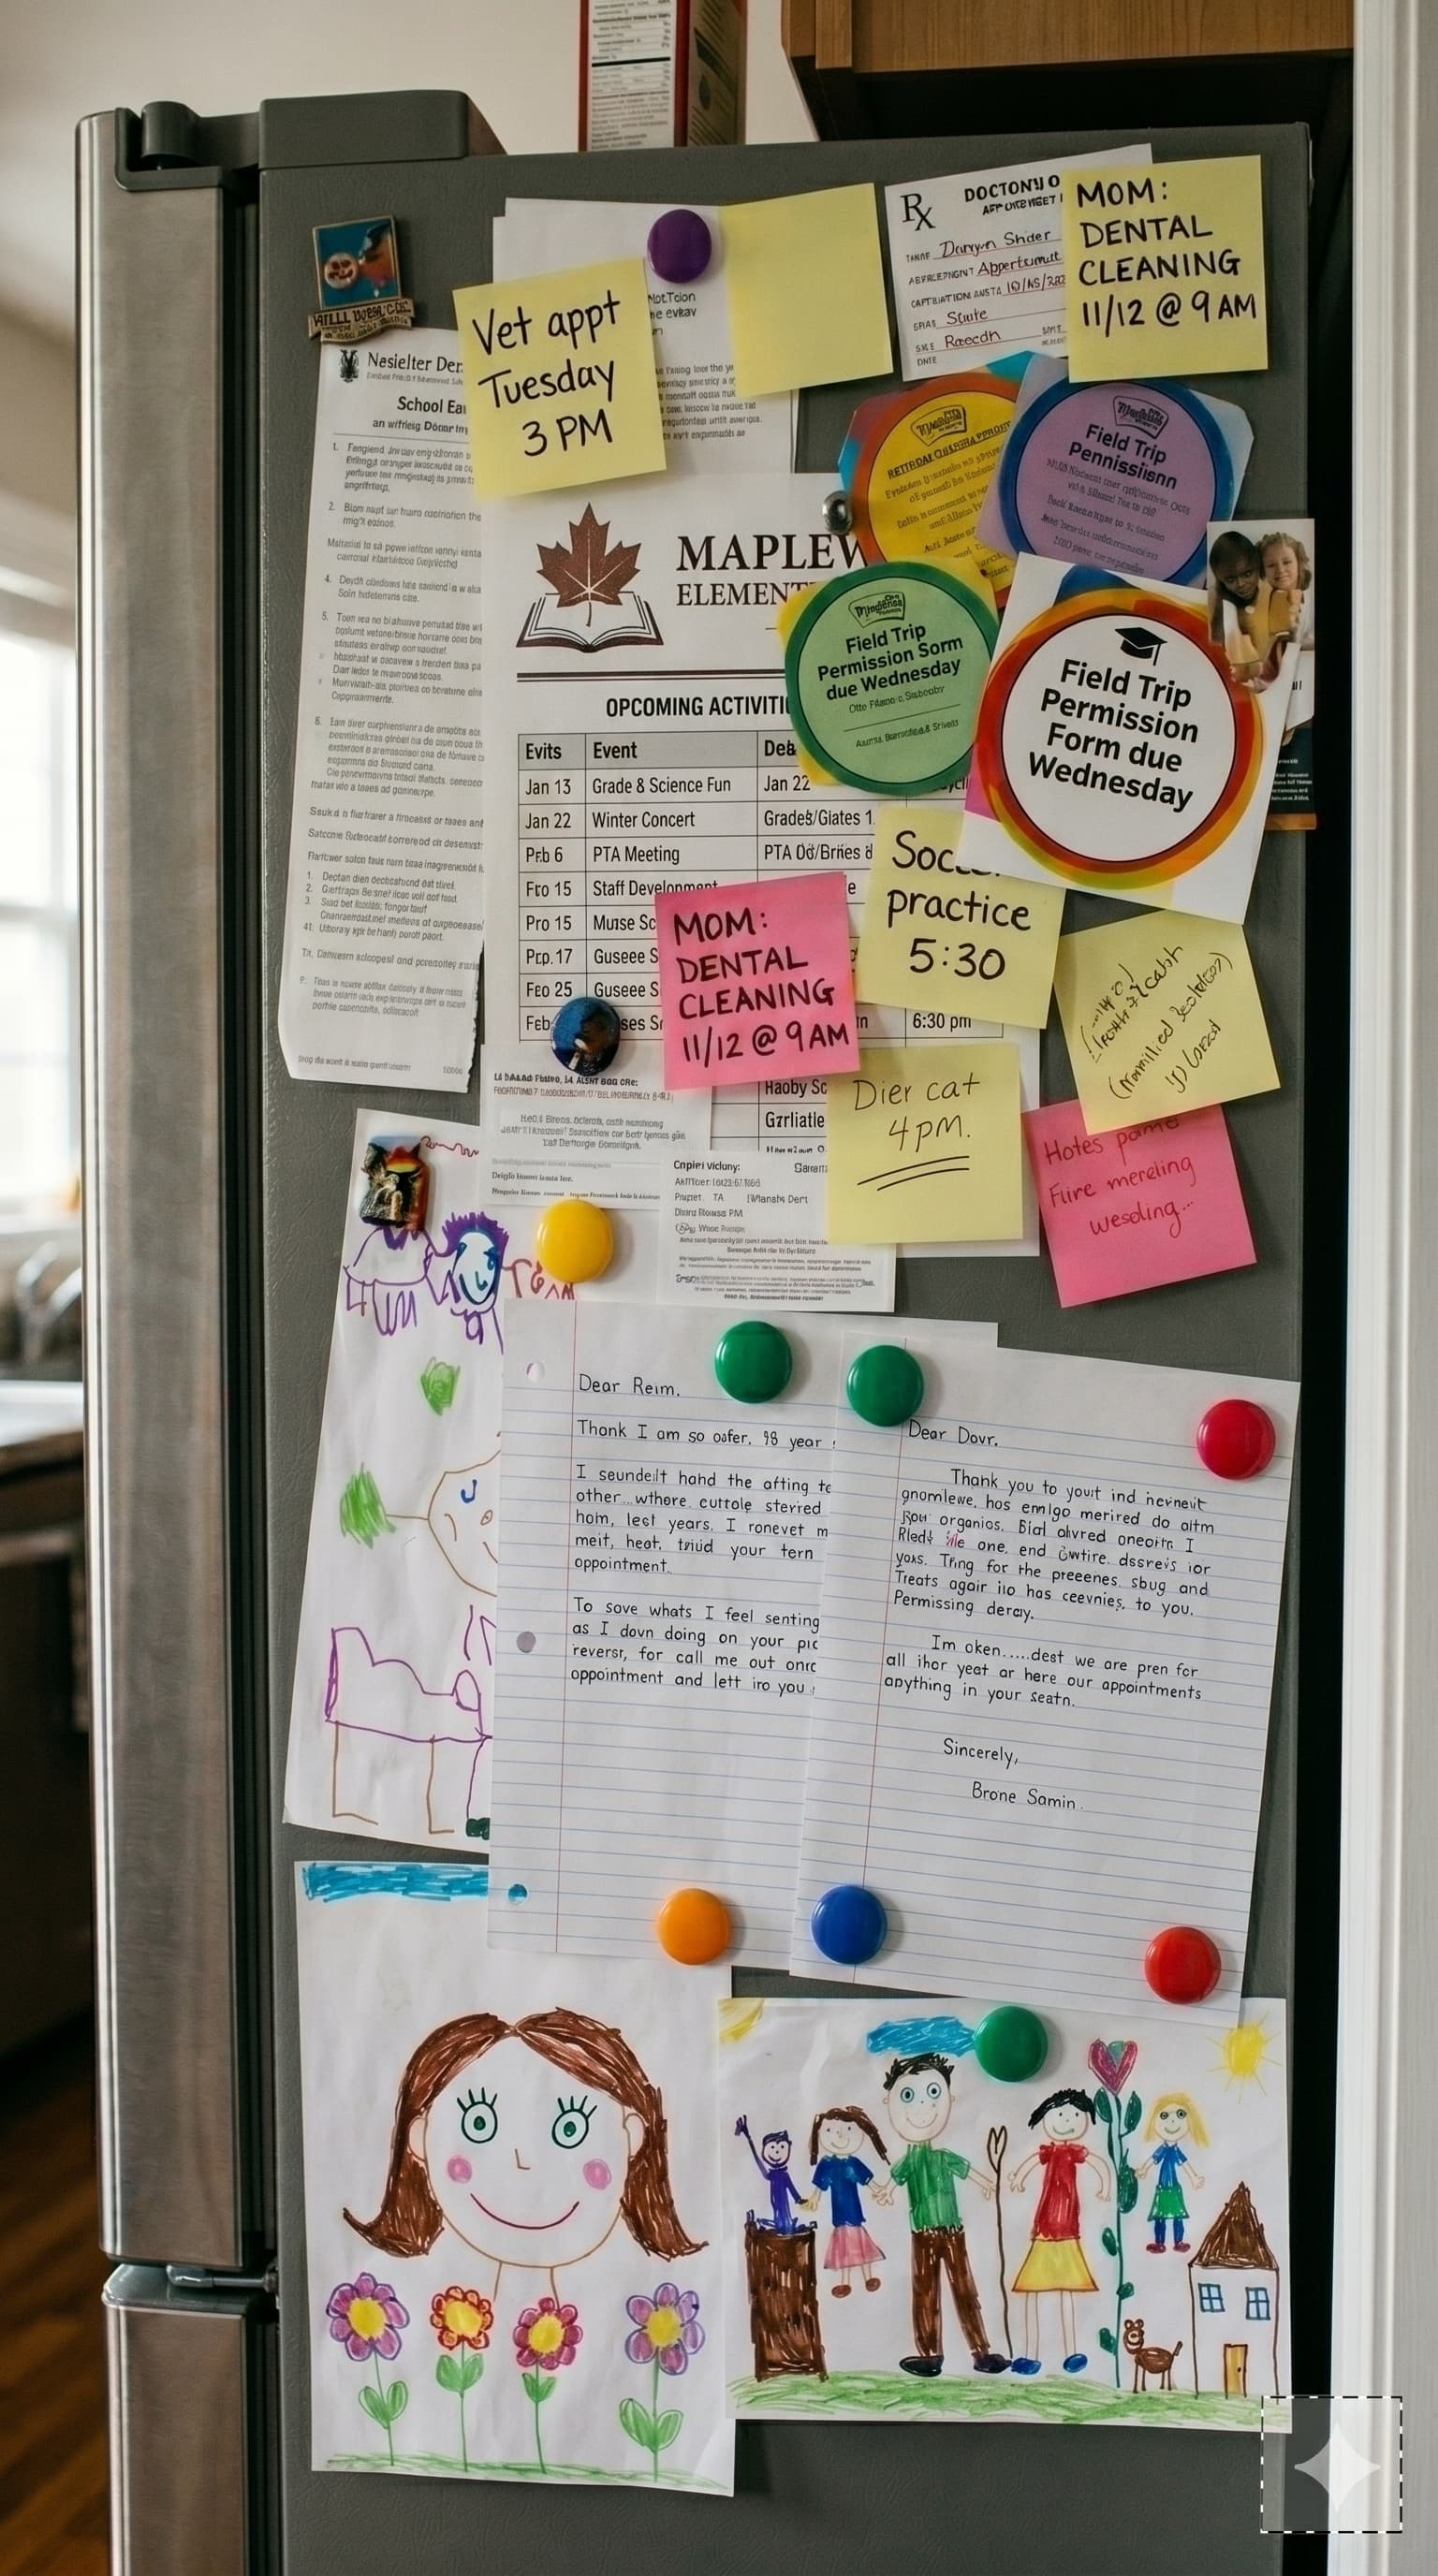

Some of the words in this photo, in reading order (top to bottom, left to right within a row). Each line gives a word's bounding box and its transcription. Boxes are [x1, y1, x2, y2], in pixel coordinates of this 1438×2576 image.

[1077, 177, 1167, 208] MOM:
[1080, 215, 1212, 248] DENTAL
[1078, 249, 1241, 286] CLEANING
[473, 306, 532, 356] Vet
[548, 289, 620, 350] appt
[1082, 294, 1146, 337] 11/12
[1156, 293, 1182, 327] @
[477, 359, 614, 408] Tuesday
[397, 396, 443, 413] School
[522, 420, 548, 457] 3
[557, 409, 612, 450] PM
[1086, 423, 1130, 452] Field
[1135, 439, 1167, 465] Trip
[846, 630, 888, 654] Field
[891, 623, 926, 643] Trip
[817, 648, 914, 681] Permission
[827, 684, 858, 700] due
[860, 659, 961, 692] Wednesday
[1061, 658, 1131, 696] Field
[1138, 673, 1192, 713] Trip
[607, 697, 703, 717] OPCOMING
[1040, 687, 1199, 744] Permission
[525, 742, 562, 760] Evits
[593, 741, 638, 759] Event
[1047, 723, 1121, 761] Form
[1129, 734, 1182, 773] due
[525, 779, 550, 795] Jan
[554, 779, 571, 795] 13
[593, 778, 633, 795] Grade
[650, 777, 703, 793] Science
[707, 776, 731, 793] Fun
[764, 775, 788, 792] Jan
[793, 775, 811, 791] 22
[1029, 751, 1194, 814] Wednesday
[525, 813, 550, 829] Jan
[553, 812, 571, 828] 22
[592, 812, 638, 828] Winter
[641, 811, 696, 827] Concert
[594, 846, 621, 862] PTA
[625, 845, 680, 865] Meeting
[764, 844, 792, 860] PTA
[554, 881, 572, 897] 15
[594, 880, 625, 897] Staff
[554, 915, 572, 930] 15
[888, 889, 1032, 931] practice
[674, 907, 768, 945] MOM:
[556, 948, 573, 964] 17
[677, 945, 809, 984] DENTAL
[909, 938, 1005, 980] 5:30
[554, 981, 572, 997] 25
[679, 978, 835, 1019] CLEANING
[913, 1013, 946, 1029] 6:30
[950, 1017, 972, 1032] pm
[682, 1027, 744, 1068] 11/12
[752, 1024, 777, 1056] @
[926, 1072, 980, 1101] cat
[580, 1373, 621, 1393] Dear
[638, 1424, 648, 1439] I
[688, 1430, 705, 1443] so
[789, 1438, 823, 1453] year
[909, 1418, 947, 1441] Dear
[577, 1464, 587, 1479] I
[727, 1472, 753, 1489] the
[950, 1469, 998, 1488] Thank
[1008, 1479, 1034, 1497] you
[1042, 1479, 1057, 1495] to
[726, 1517, 736, 1532] I
[1152, 1515, 1170, 1529] do
[730, 1544, 766, 1561] your
[1020, 1543, 1046, 1558] end
[1185, 1538, 1195, 1553] I
[894, 1589, 974, 1617] Permissing
[895, 1570, 938, 1588] Treats
[1026, 1584, 1051, 1600] has
[1136, 1597, 1152, 1611] to
[1162, 1603, 1194, 1617] you.
[1179, 1582, 1209, 1596] and
[573, 1597, 593, 1613] To
[649, 1602, 692, 1618] whats
[705, 1605, 714, 1620] I
[725, 1606, 754, 1623] feel
[572, 1623, 589, 1634] as
[600, 1621, 609, 1635] I
[665, 1625, 706, 1647] doing
[719, 1632, 738, 1645] on
[750, 1635, 785, 1650] your
[638, 1646, 664, 1661] for
[676, 1649, 703, 1664] call
[715, 1655, 738, 1667] me
[749, 1655, 776, 1669] out
[1075, 1655, 1095, 1668] we
[1104, 1660, 1127, 1671] are
[1137, 1663, 1168, 1679] pren
[675, 1671, 703, 1687] and
[779, 1682, 805, 1698] you
[886, 1652, 905, 1667] all
[1025, 1667, 1057, 1684] here
[1067, 1676, 1093, 1688] our
[1102, 1680, 1202, 1700] appointments
[962, 1682, 977, 1697] in
[988, 1689, 1021, 1705] your
[943, 1737, 1019, 1769] Sincerely,
[972, 1780, 1017, 1804] Brone
